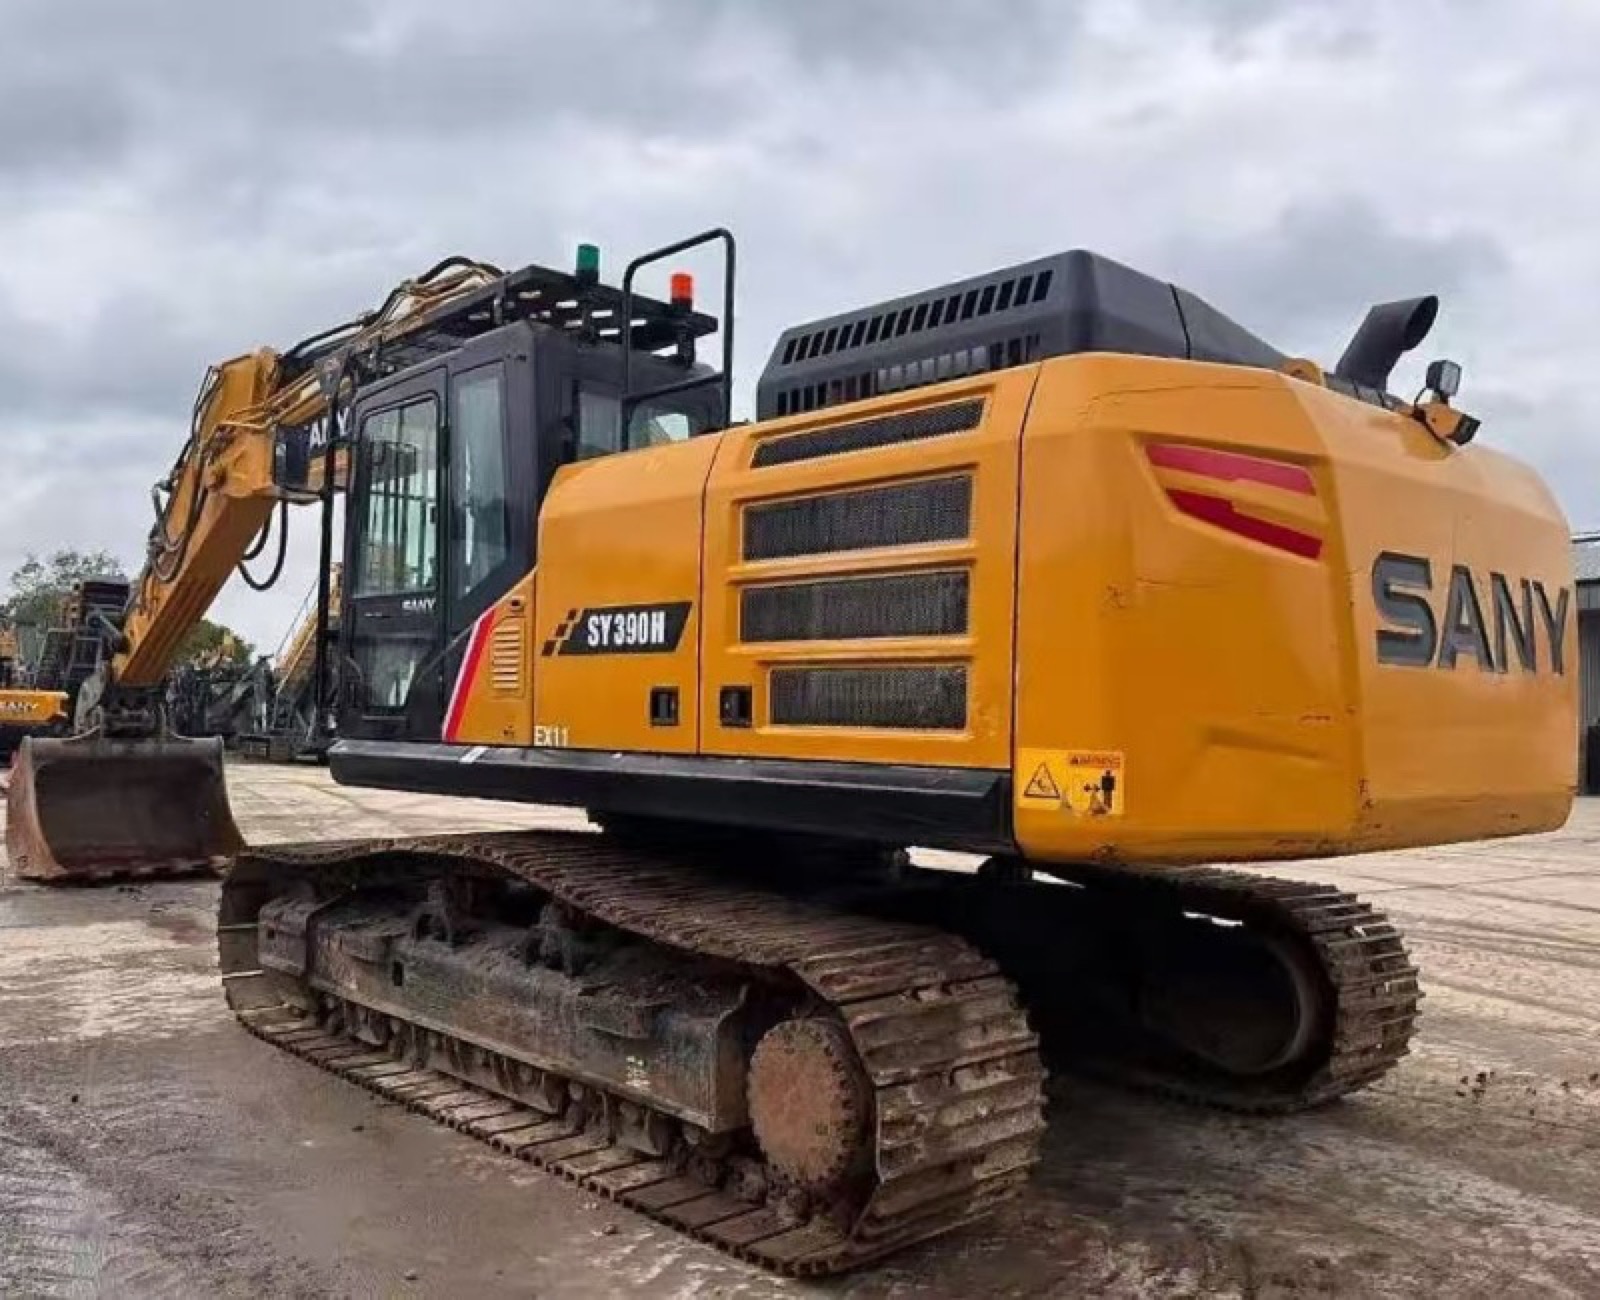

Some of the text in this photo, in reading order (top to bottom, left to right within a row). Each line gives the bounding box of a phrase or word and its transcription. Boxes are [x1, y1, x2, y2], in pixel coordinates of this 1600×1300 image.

[587, 611, 665, 647] SY390H
[1371, 550, 1569, 676] SANY
[534, 725, 569, 747] EX11
